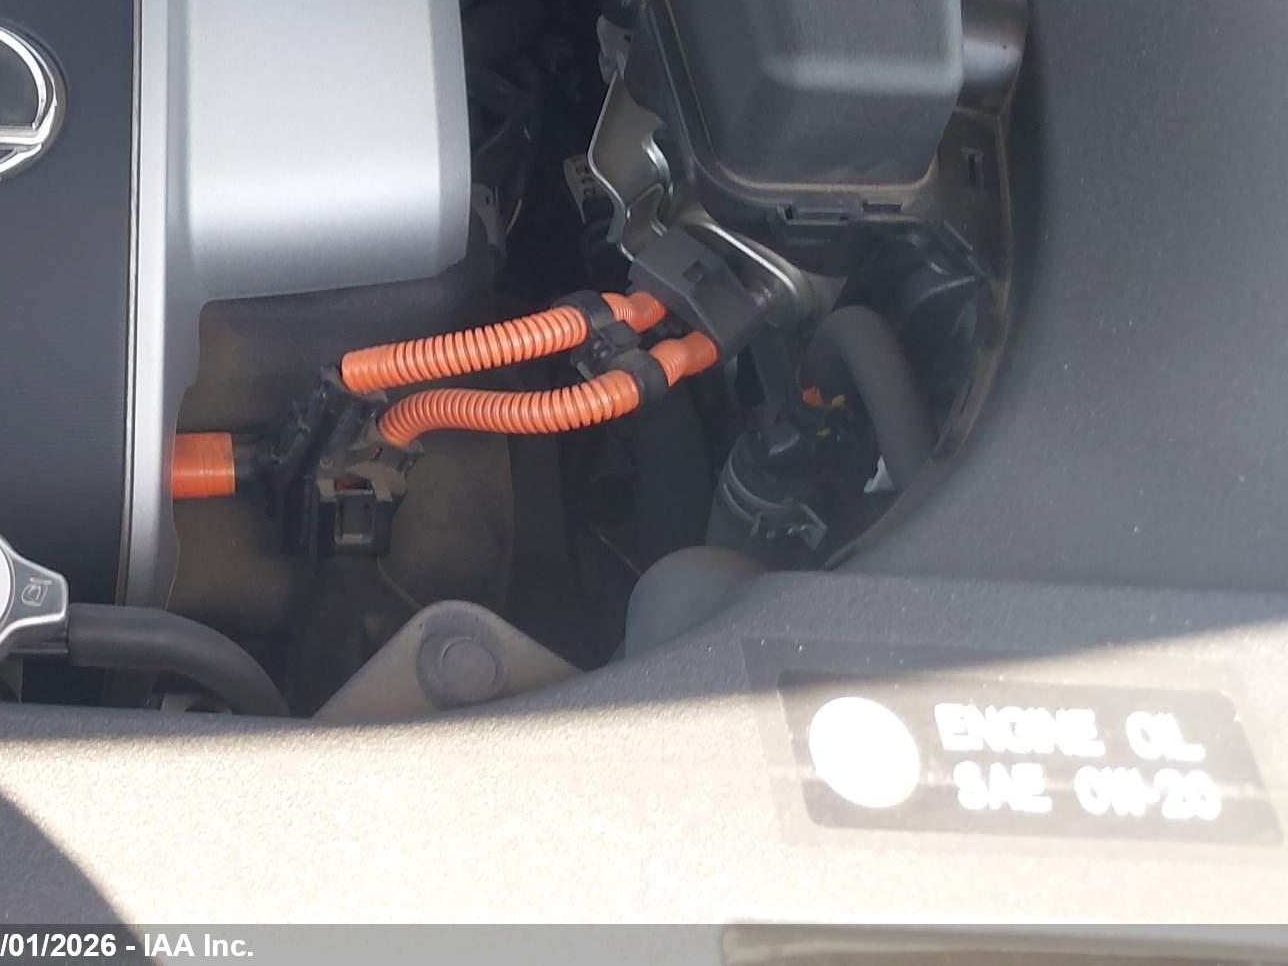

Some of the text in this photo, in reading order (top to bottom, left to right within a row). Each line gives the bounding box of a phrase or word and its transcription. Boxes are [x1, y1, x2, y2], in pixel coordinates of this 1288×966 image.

[933, 702, 1206, 763] ENGINE OIL
[952, 760, 1053, 813] SAE
